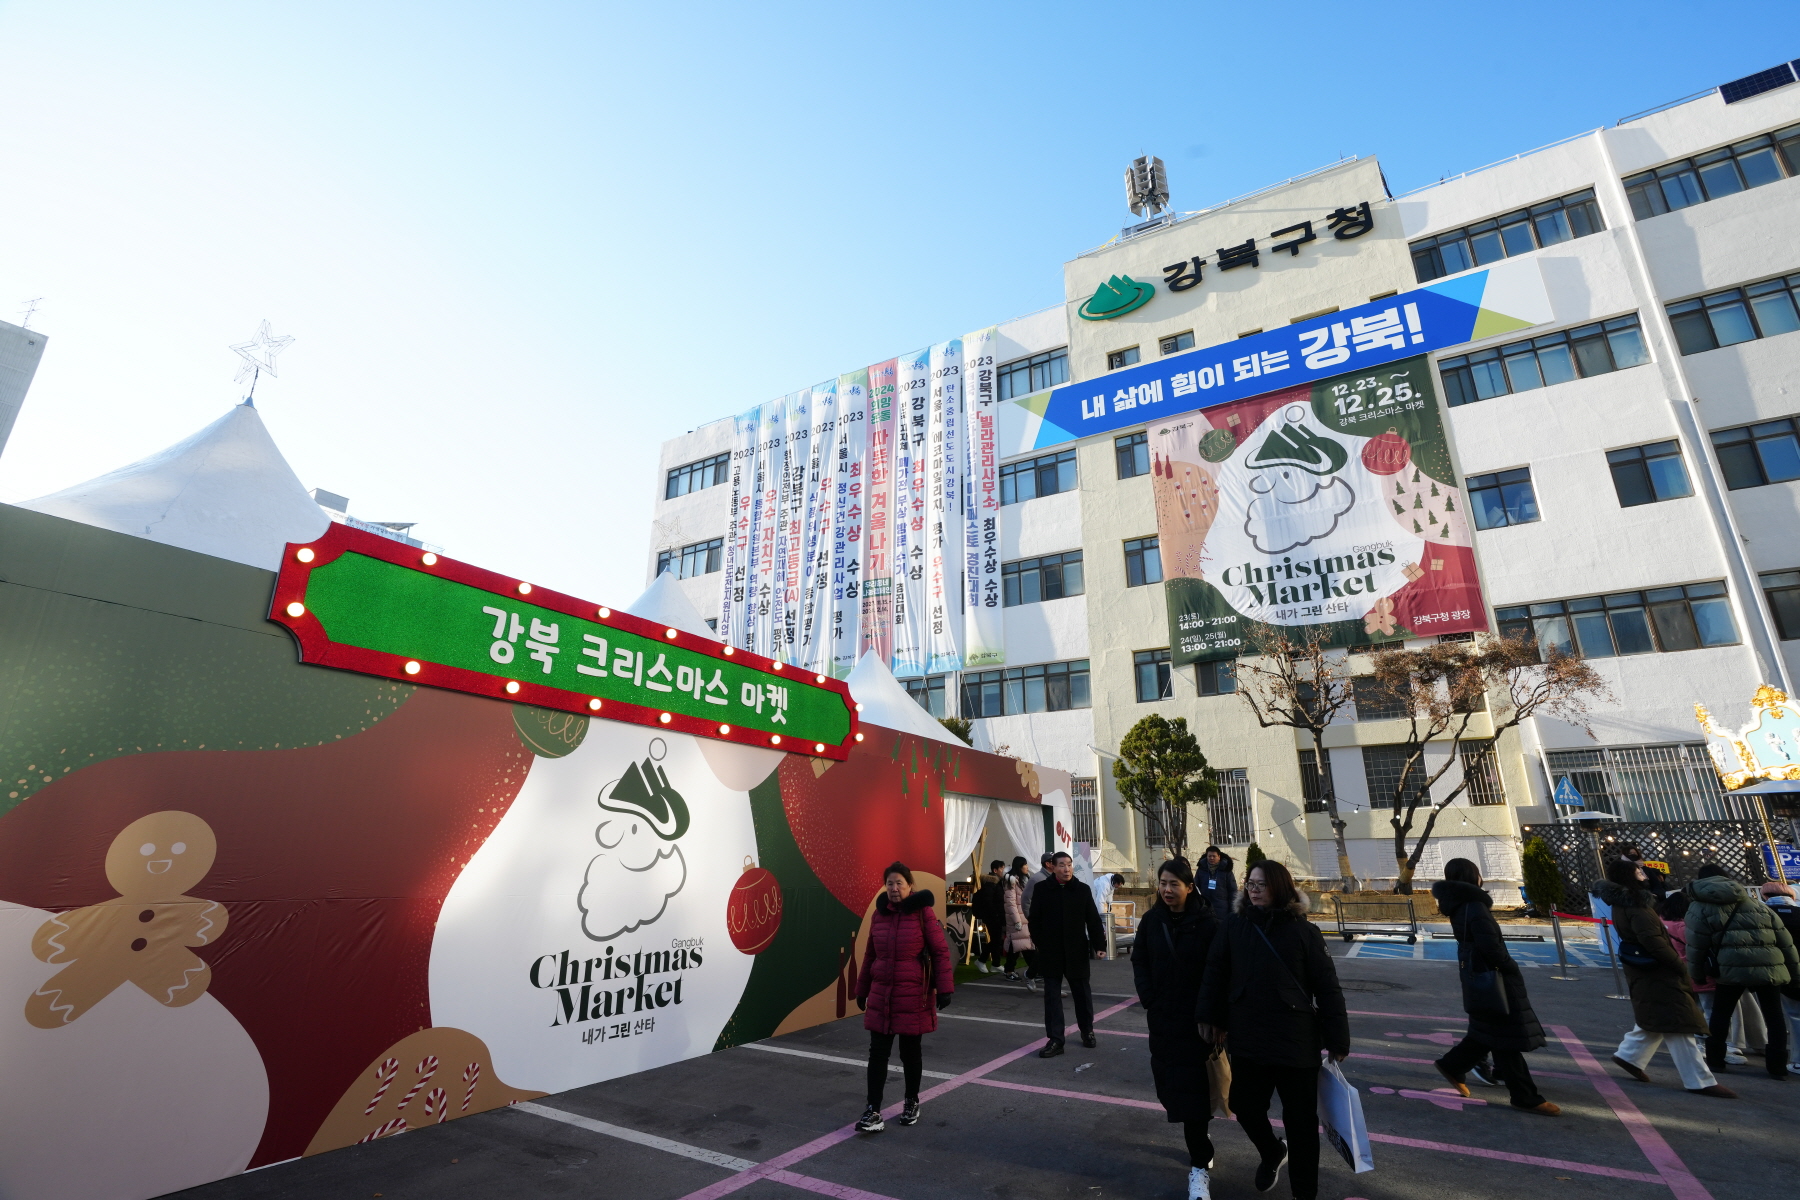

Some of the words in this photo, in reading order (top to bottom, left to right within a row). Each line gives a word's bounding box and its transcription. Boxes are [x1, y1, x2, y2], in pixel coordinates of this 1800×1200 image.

[1163, 201, 1374, 292] 강북구청
[930, 366, 959, 382] 2023
[964, 356, 993, 372] 2023
[1081, 395, 1106, 420] 내
[1113, 379, 1163, 411] 삶에
[1171, 363, 1224, 398] 힘이
[1234, 350, 1290, 382] 되는
[1299, 302, 1424, 370] 강북!
[869, 384, 894, 399] 2024
[899, 379, 926, 394] 2023
[979, 370, 992, 406] 강북구
[1332, 377, 1382, 396] 12.23.
[1334, 382, 1421, 416] 12.25.
[839, 411, 863, 426] 2023
[871, 397, 892, 412] 희망
[933, 386, 942, 424] 서울시
[1339, 415, 1357, 426] 강북
[1359, 405, 1404, 422] 크리스마스
[1406, 400, 1424, 411] 마켓
[785, 430, 808, 444] 2023
[811, 422, 834, 436] 2023
[912, 397, 925, 446] 강북구
[734, 447, 754, 460] 2023
[758, 439, 780, 452] 2023
[838, 433, 848, 473] 서울시
[871, 428, 888, 486] 따뜻한
[756, 460, 764, 493] 서울시
[811, 443, 820, 482] 서울시
[764, 490, 777, 520] 우수
[791, 466, 805, 513] 강북구
[847, 461, 862, 542] 최우수상
[911, 459, 924, 531] 최우수상
[737, 496, 750, 550] 우수구
[780, 508, 788, 532] 주관
[818, 478, 832, 535] 우수구
[897, 494, 907, 519] 무상
[869, 492, 887, 570] 겨울나기
[933, 522, 943, 549] 평가
[984, 517, 997, 574] 최우수상
[1352, 540, 1393, 553] Gangbuk
[761, 526, 775, 575] 자치구
[909, 545, 923, 580] 수상
[734, 566, 745, 602] 선정
[817, 550, 829, 589] 선정
[846, 559, 860, 598] 수상
[933, 556, 942, 598] 우수구
[967, 552, 979, 606] 경진대회
[1222, 548, 1395, 587] Christmas
[758, 583, 771, 616] 수상
[984, 579, 998, 607] 수상
[1243, 571, 1378, 608] Market
[784, 609, 796, 644] 선정
[833, 610, 843, 640] 평가
[933, 605, 942, 634] 선정
[1179, 620, 1204, 630] 14:00
[1212, 616, 1236, 625] 21:00
[1276, 607, 1298, 620] 내가
[1301, 605, 1322, 617] 그린
[1325, 601, 1349, 615] 산타
[1413, 612, 1449, 625] 강북구청
[1451, 609, 1470, 621] 광장
[773, 628, 782, 652] 평가
[1181, 643, 1207, 653] 13:00
[1215, 638, 1240, 648] 21:00
[482, 605, 560, 674] 강북
[576, 633, 728, 708] 크리스마스
[741, 680, 788, 726] 마켓
[1056, 821, 1071, 848] OUT
[671, 936, 704, 949] Gangbuk
[530, 944, 703, 989] Christmas
[550, 970, 685, 1027] Market
[582, 1024, 606, 1045] 내가
[608, 1021, 631, 1039] 그린
[634, 1016, 656, 1034] 산타
